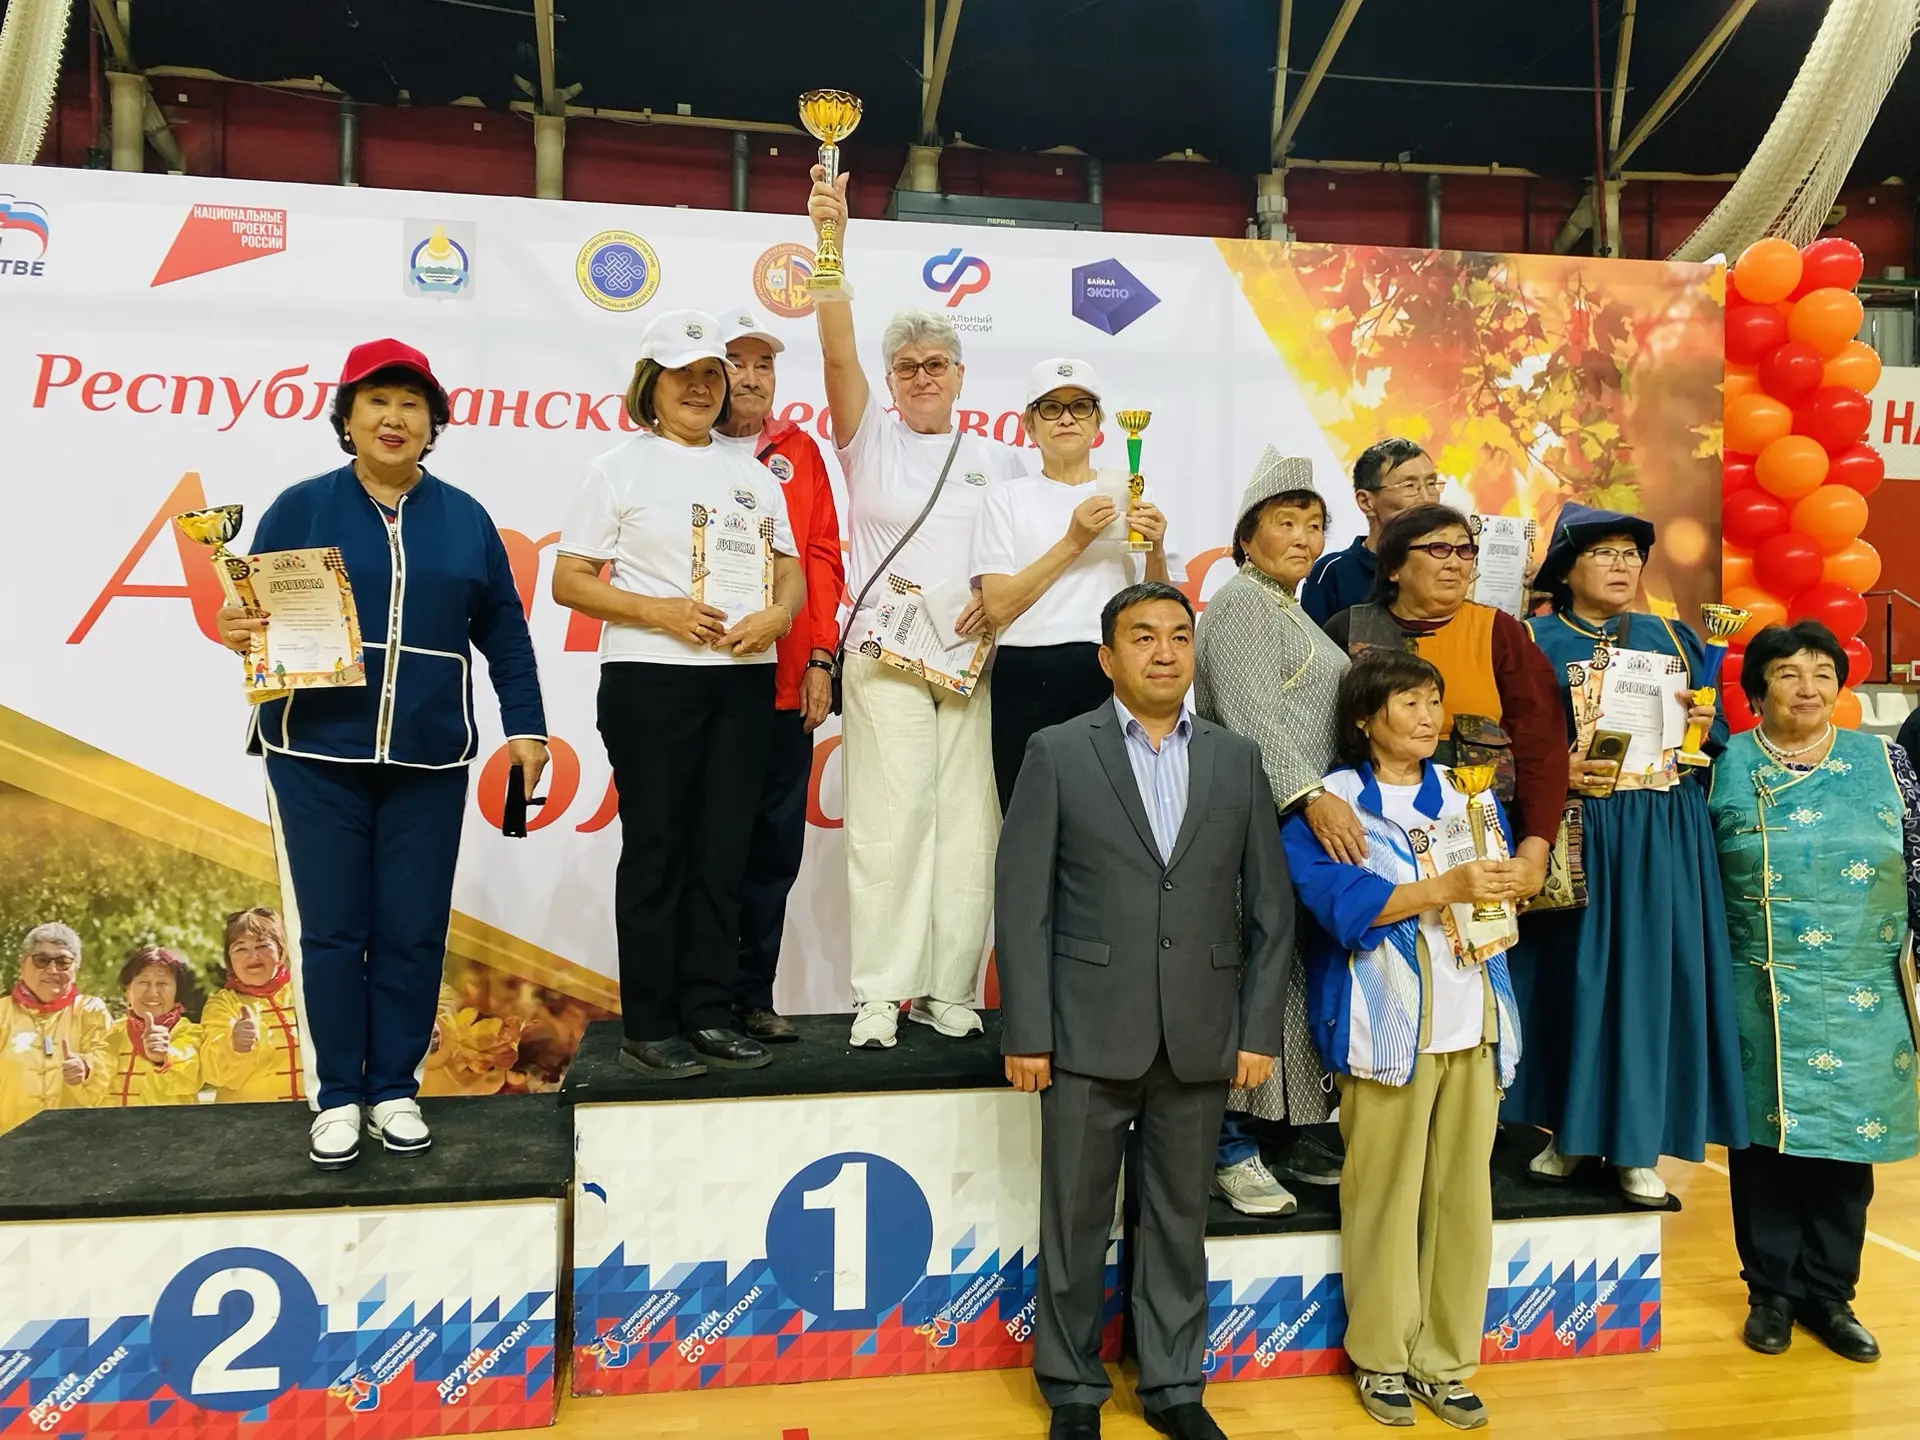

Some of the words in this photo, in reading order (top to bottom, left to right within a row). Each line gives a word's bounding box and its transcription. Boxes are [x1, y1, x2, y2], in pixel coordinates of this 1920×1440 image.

[194, 206, 283, 223] НАЦИОНАЛЬНЫЕ
[232, 221, 283, 236] ПРОЕКТЫ
[987, 218, 1016, 226] ПЕРИОД
[241, 235, 283, 249] РОССИИ
[1086, 287, 1129, 299] ЭКСПО
[1087, 277, 1116, 286] БАЙКАЛ
[947, 314, 992, 324] АЛЬНЫЙ
[953, 323, 992, 332] РОССИИ
[716, 538, 756, 555] ДИПЛОМ
[269, 578, 324, 593] ДИПЛОМ
[894, 604, 918, 645] ДИПЛОМ
[1614, 680, 1661, 696] ДИПЛОМ
[803, 1161, 868, 1311] 1
[621, 1293, 659, 1333] ДИРЕКЦИЯ
[626, 1290, 674, 1338] СПОРТИВНЫХ
[950, 1276, 985, 1313] ДИРЕКЦИЯ
[956, 1272, 1000, 1318] СПОРТИВНЫХ
[961, 1277, 1005, 1324] СООРУЖЕНИЙ
[1513, 1288, 1541, 1321] ДИРЕКЦИЯ
[1517, 1285, 1551, 1325] СПОРТИВНЫХ
[1562, 1331, 1576, 1347] СО
[1575, 1282, 1618, 1332] СПОРТОМ!
[191, 1267, 281, 1395] 2
[633, 1295, 681, 1343] СООРУЖЕНИЙ
[677, 1310, 721, 1358] ДРУЖИ
[687, 1345, 706, 1364] СО
[704, 1285, 763, 1345] СПОРТОМ!
[1005, 1295, 1036, 1337] ДРУЖ
[1014, 1324, 1031, 1342] СО
[1261, 1352, 1276, 1368] СО
[1275, 1300, 1321, 1352] СПОРТОМ!
[1554, 1301, 1587, 1341] ДРУЖИ
[371, 1330, 413, 1373] ДИРЕКЦИЯ
[377, 1327, 431, 1379] СПОРТИВНЫХ
[384, 1331, 438, 1384] СООРУЖЕНИЙ
[447, 1384, 467, 1405] СО
[467, 1320, 532, 1385] СПОРТОМ!
[1253, 1322, 1288, 1363] ДРУЖИ
[39, 1411, 62, 1432] СО
[59, 1345, 129, 1412] СПОРТОМ!
[436, 1347, 486, 1398] ДРУЖИ
[28, 1371, 80, 1425] ДРУЖИ
